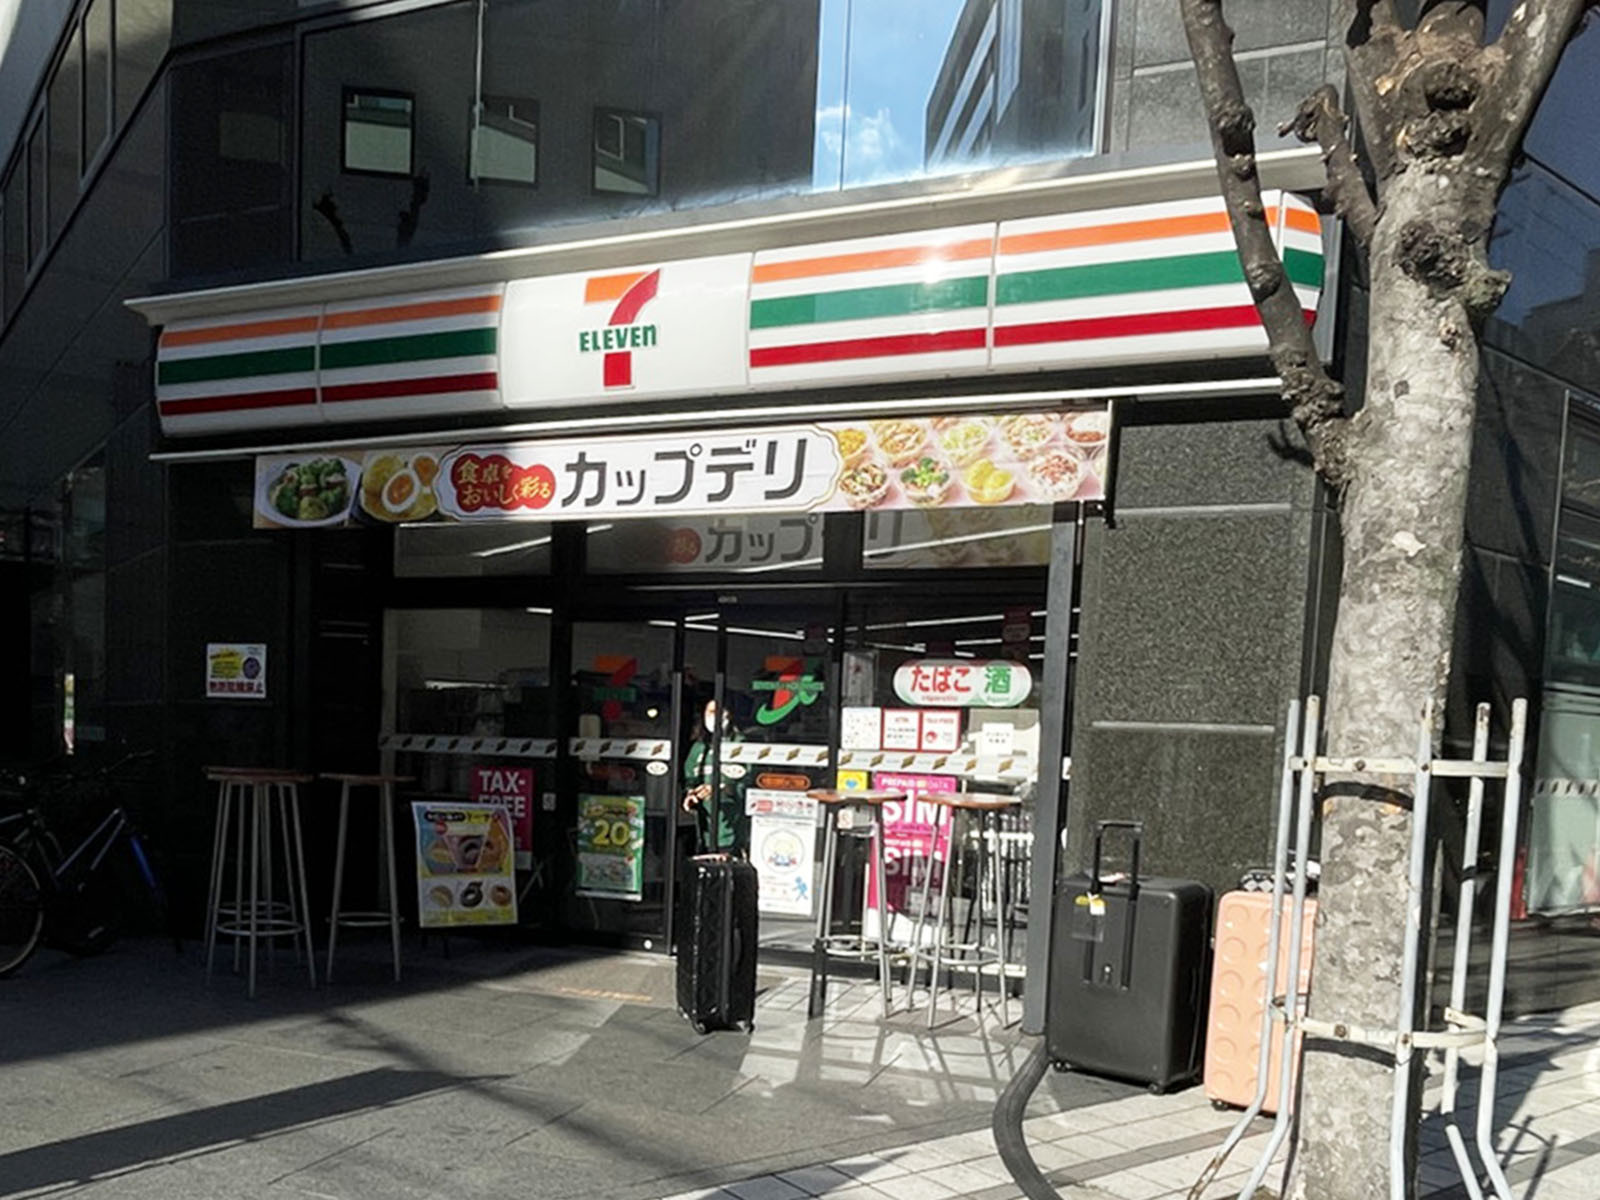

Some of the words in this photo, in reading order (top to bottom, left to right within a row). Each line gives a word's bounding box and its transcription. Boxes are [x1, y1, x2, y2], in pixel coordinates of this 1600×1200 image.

[561, 438, 807, 508] カップデリ
[911, 665, 972, 693] たばこ
[984, 666, 1012, 694] 酒
[478, 770, 526, 793] TAX-
[882, 786, 949, 827] SIM
[593, 819, 630, 846] 20
